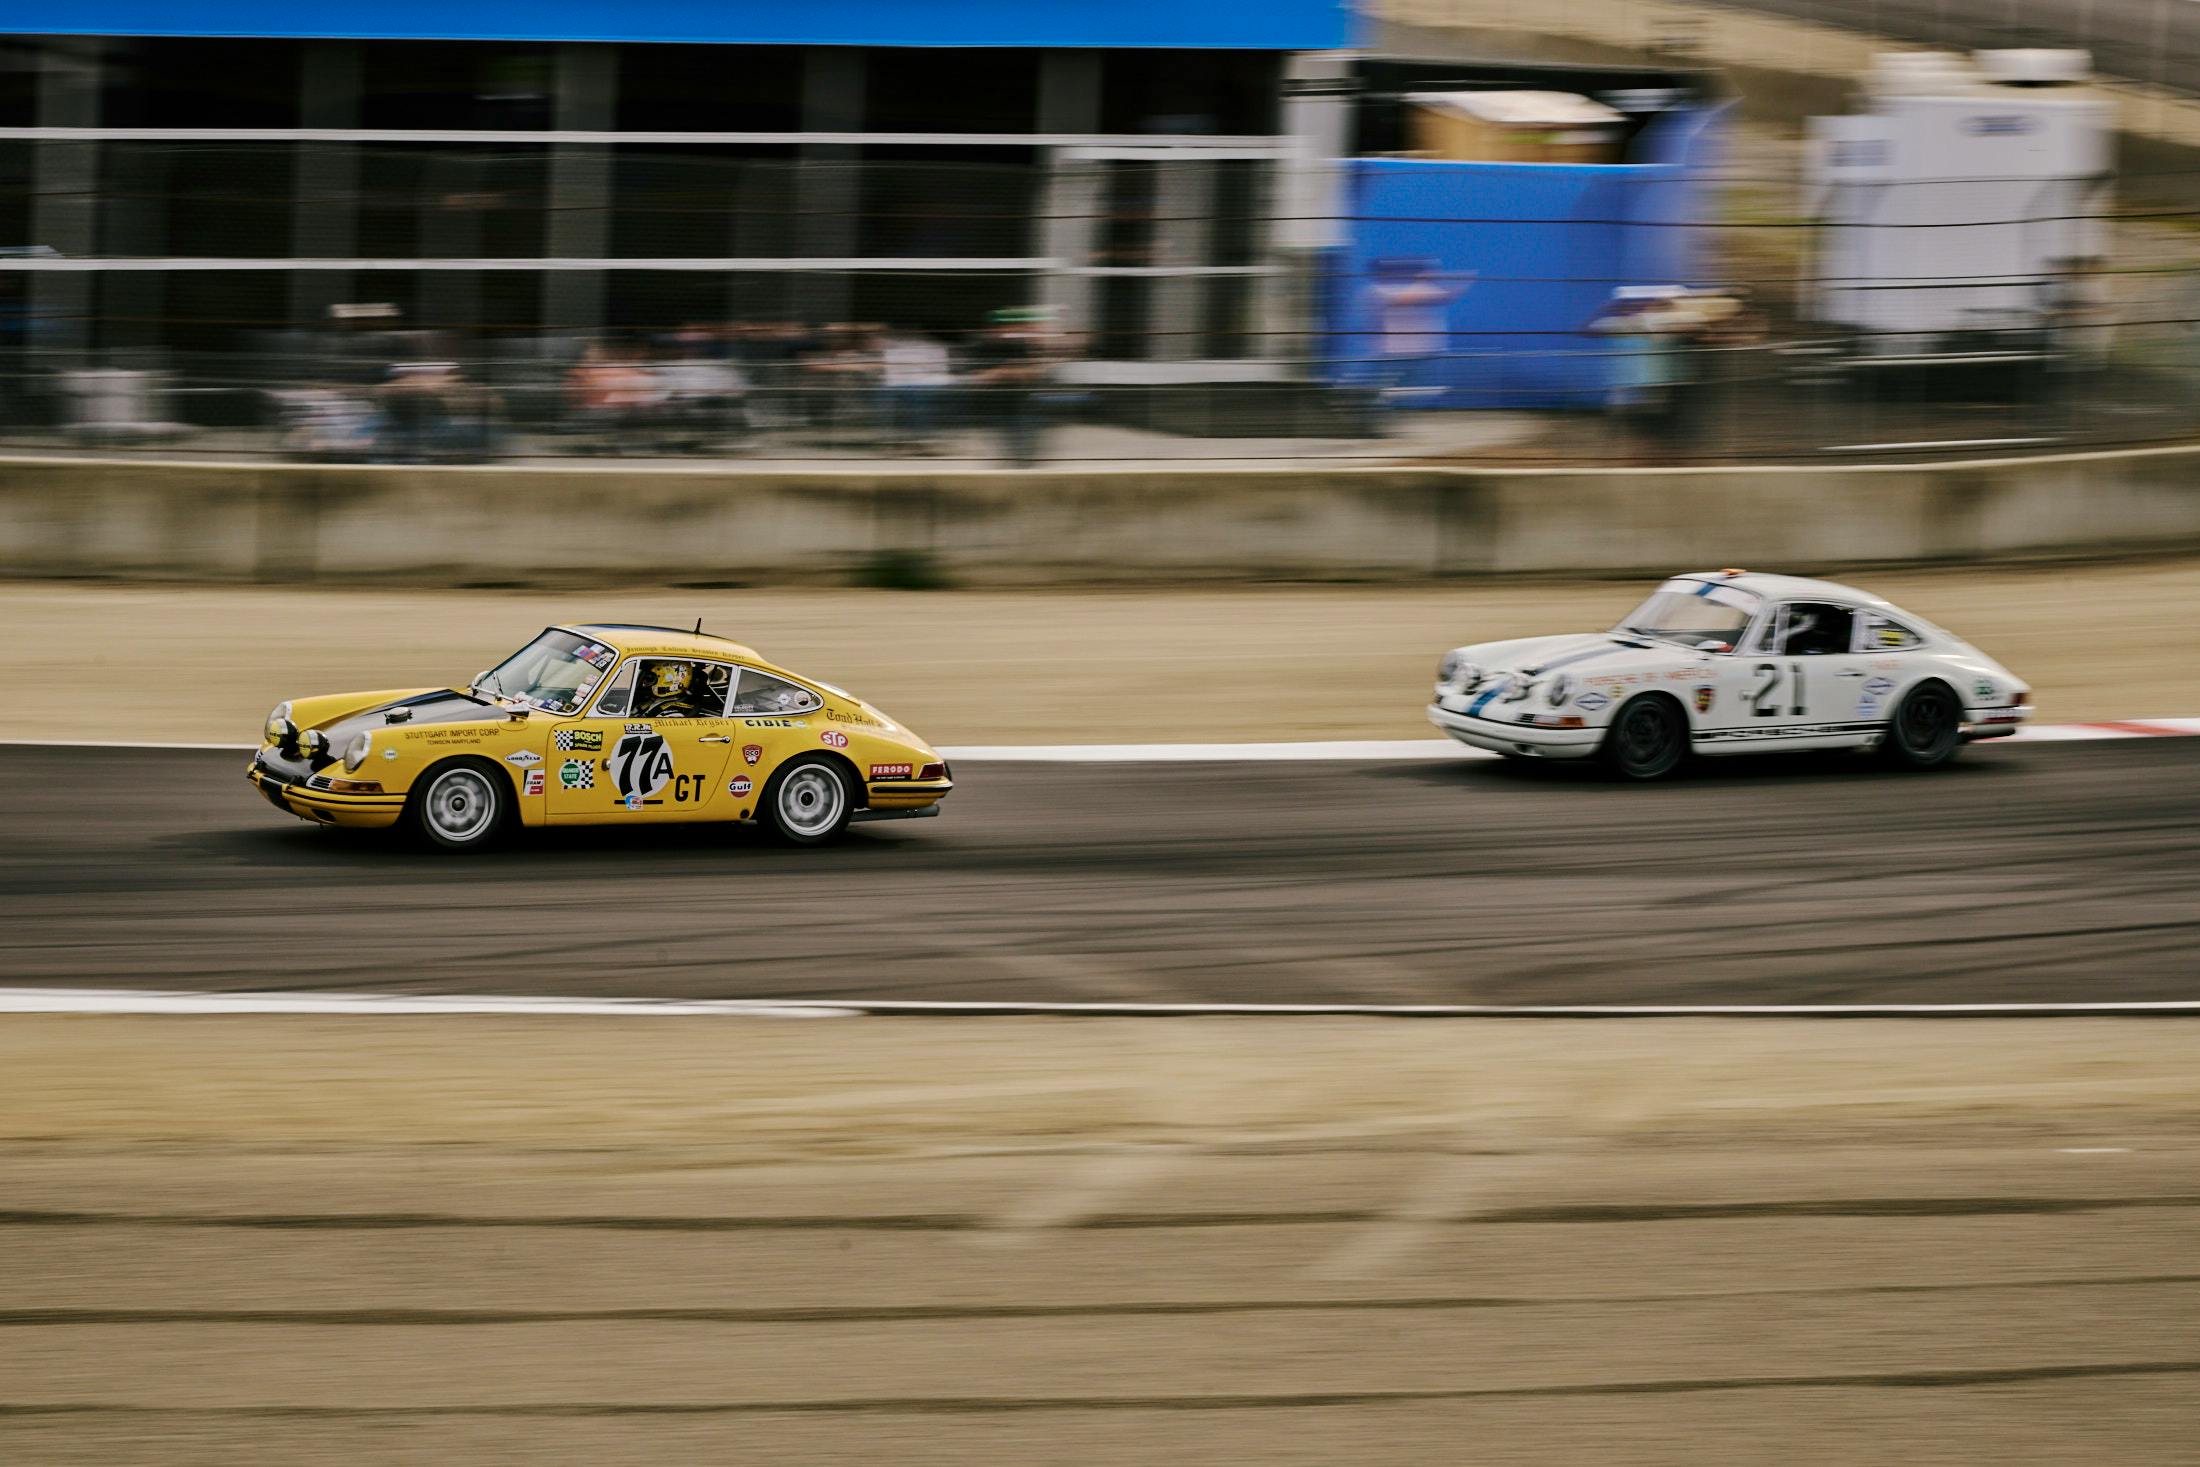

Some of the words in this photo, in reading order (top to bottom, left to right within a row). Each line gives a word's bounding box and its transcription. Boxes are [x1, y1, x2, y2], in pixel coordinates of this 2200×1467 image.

[1753, 664, 1807, 717] 21
[826, 708, 853, 724] Toad
[745, 719, 792, 728] CIBIE
[404, 730, 447, 740] STUTTGART
[450, 728, 478, 738] IMPORT
[574, 731, 602, 742] BOSCH
[822, 730, 847, 748] STP
[872, 765, 911, 774] FERODO
[674, 774, 706, 802] GT
[729, 782, 752, 791] Gulf
